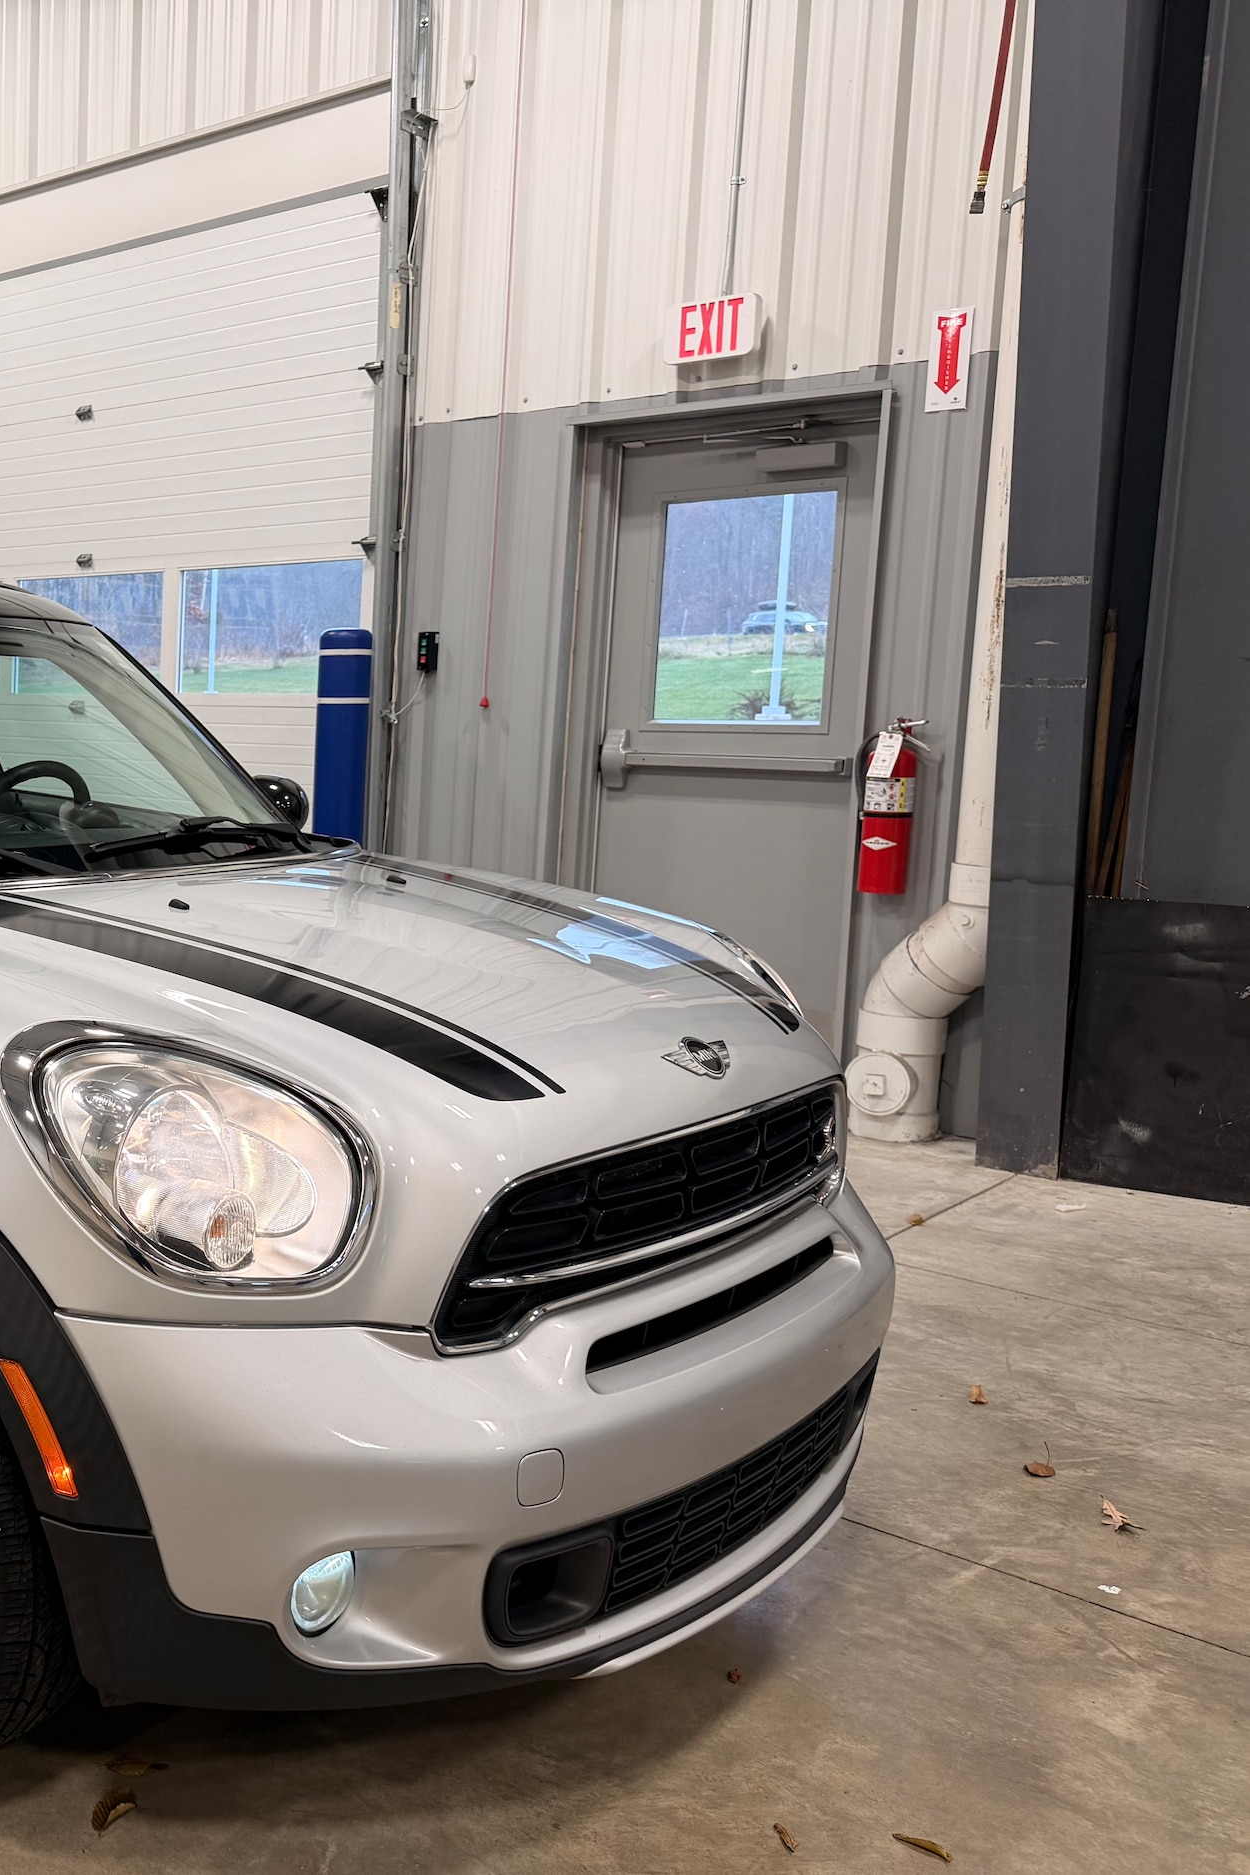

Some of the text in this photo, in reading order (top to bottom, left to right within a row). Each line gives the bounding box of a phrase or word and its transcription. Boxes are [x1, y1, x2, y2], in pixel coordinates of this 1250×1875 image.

[679, 297, 744, 358] EXIT
[940, 317, 963, 328] FIRE
[944, 328, 953, 391] INGUISHER
[691, 1047, 719, 1063] MINI
